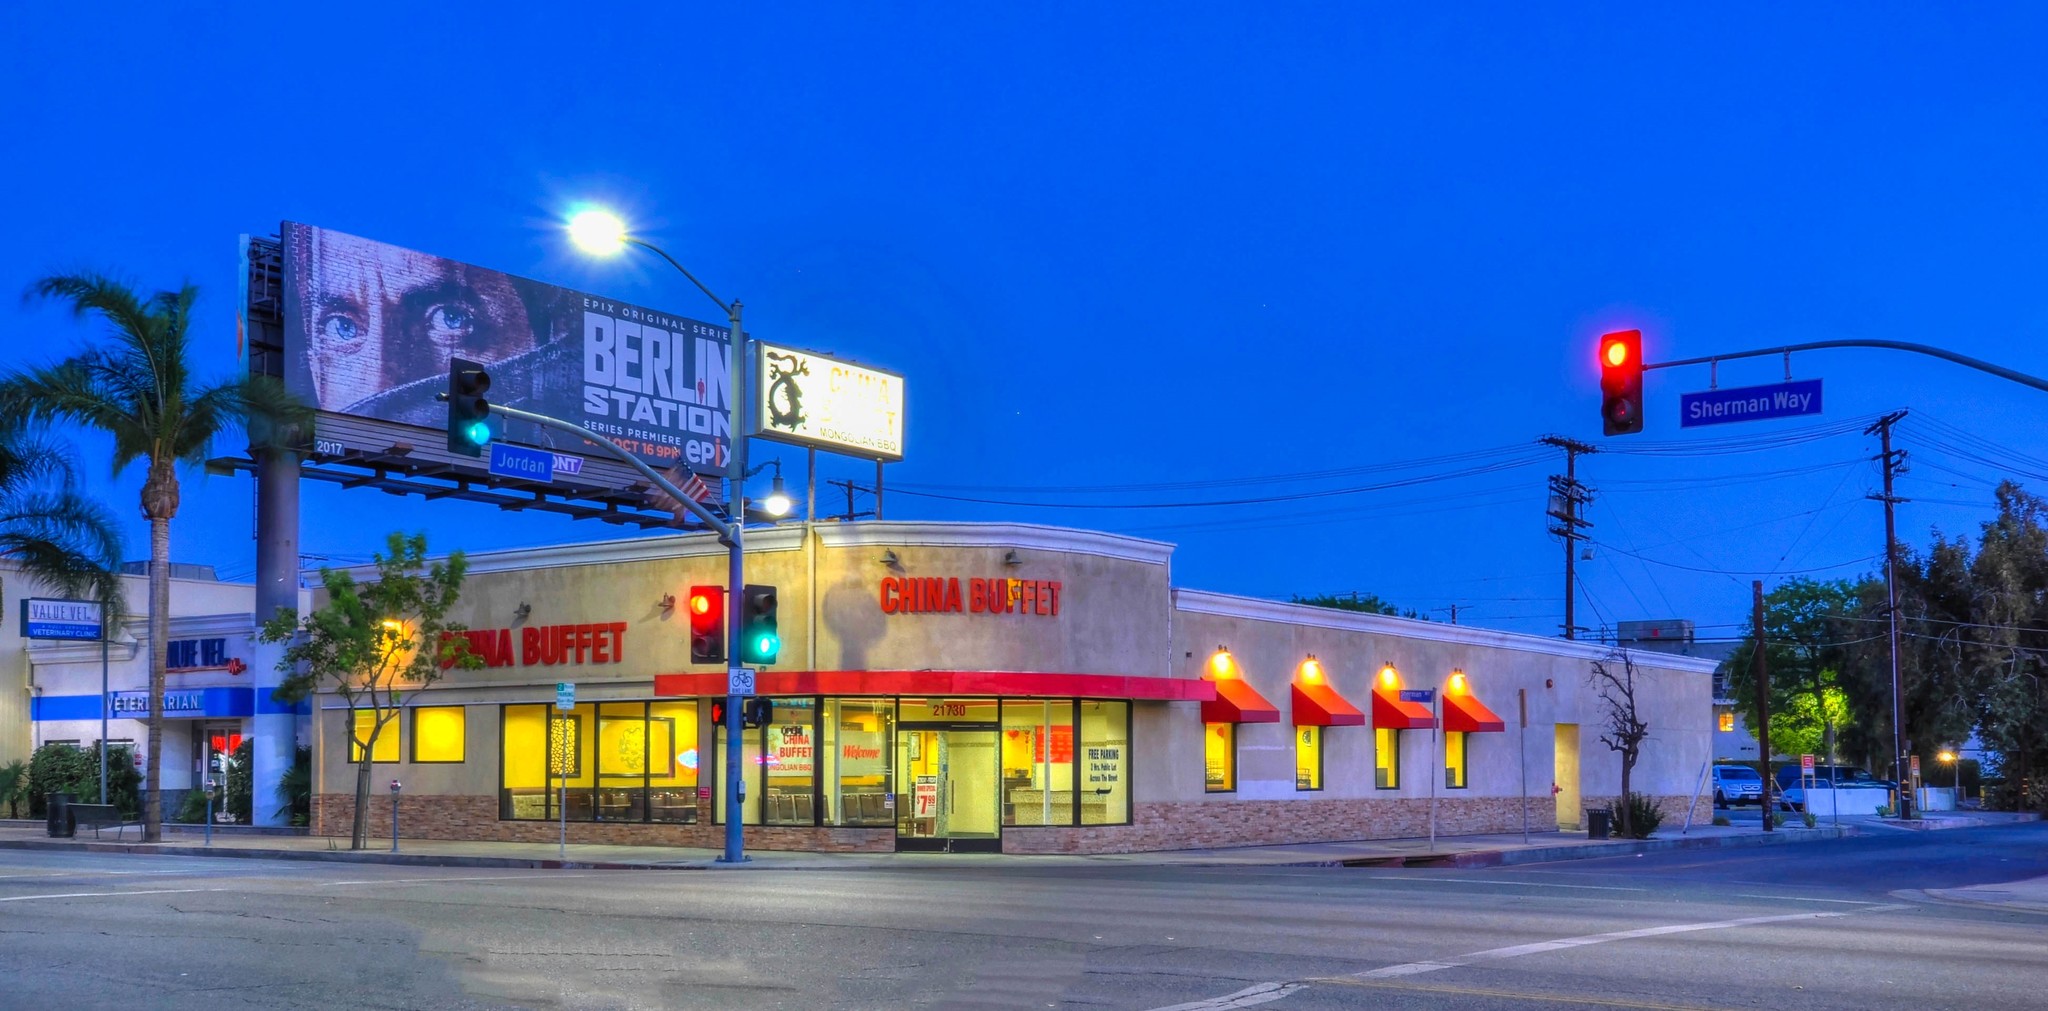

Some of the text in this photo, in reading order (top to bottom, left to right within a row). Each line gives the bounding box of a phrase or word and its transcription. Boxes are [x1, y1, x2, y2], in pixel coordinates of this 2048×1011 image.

[584, 298, 731, 341] EPIX ORIGINAL SERIE
[584, 311, 731, 411] BERLIN
[584, 385, 731, 438] STATION
[1690, 392, 1812, 419] Sherman Way
[584, 420, 623, 435] SERIES
[628, 428, 681, 446] PREMIERE
[820, 427, 897, 452] MONGOLIAN BBQ
[317, 440, 342, 454] 2017
[616, 437, 640, 453] OCT
[642, 444, 654, 455] 16
[498, 452, 545, 474] Jordan
[880, 576, 1063, 616] CHINA BUFFET
[32, 604, 87, 620] VALUE VET
[32, 628, 75, 637] VETERINARY
[437, 621, 628, 670] CINA BUFFET
[106, 695, 199, 711] VETERIARIAN
[933, 704, 966, 717] 21730
[783, 734, 810, 745] CHINA
[780, 746, 813, 758] BUFFET
[843, 745, 880, 760] Welcome
[1088, 748, 1119, 760] FREE PARKING
[799, 763, 812, 771] BBQ
